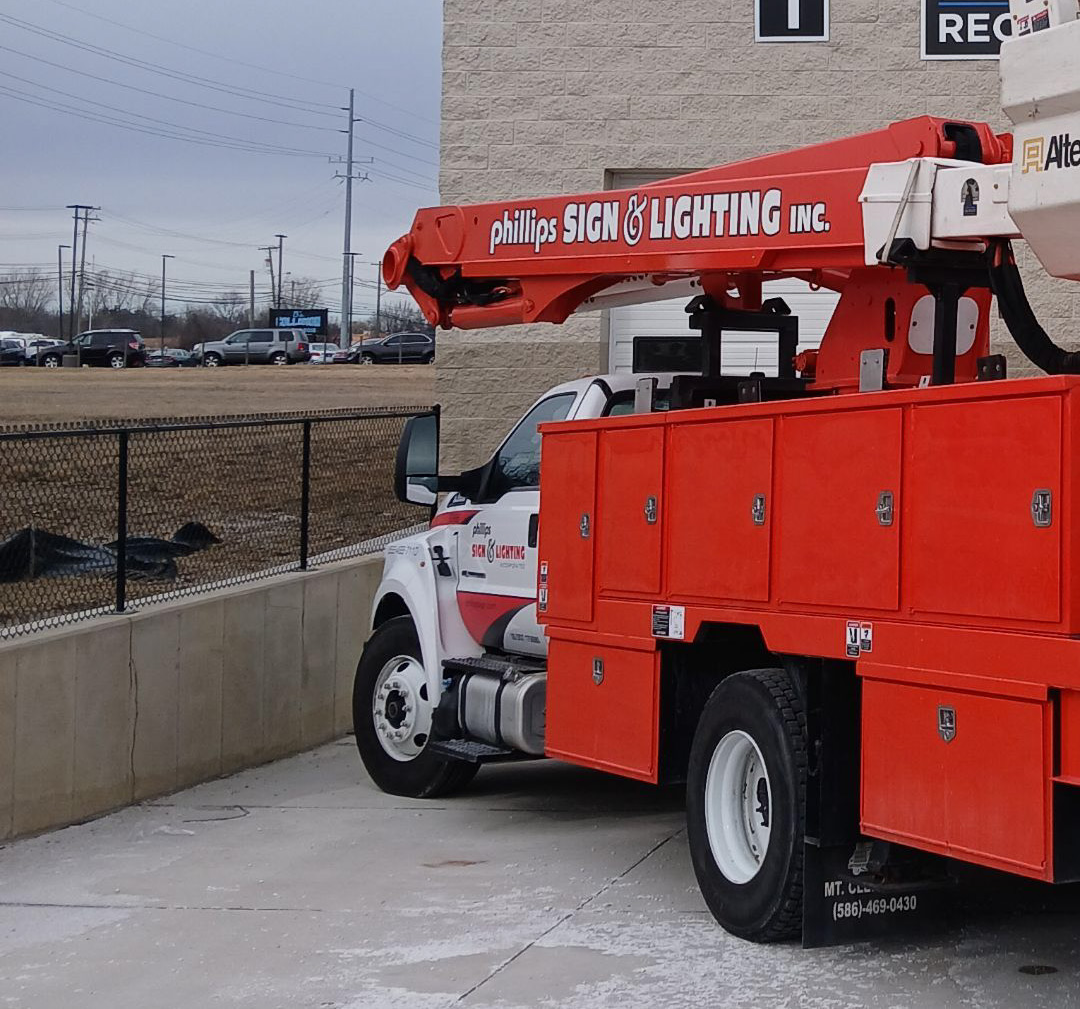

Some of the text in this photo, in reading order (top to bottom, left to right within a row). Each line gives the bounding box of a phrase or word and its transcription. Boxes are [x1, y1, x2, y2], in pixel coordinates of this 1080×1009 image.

[489, 187, 831, 255] phillips SIGN & LIGHTING INC.
[471, 544, 486, 558] SIGN
[495, 545, 525, 560] LIGHTING
[824, 880, 845, 898] MT.
[832, 895, 918, 921] (586)-469-0430
